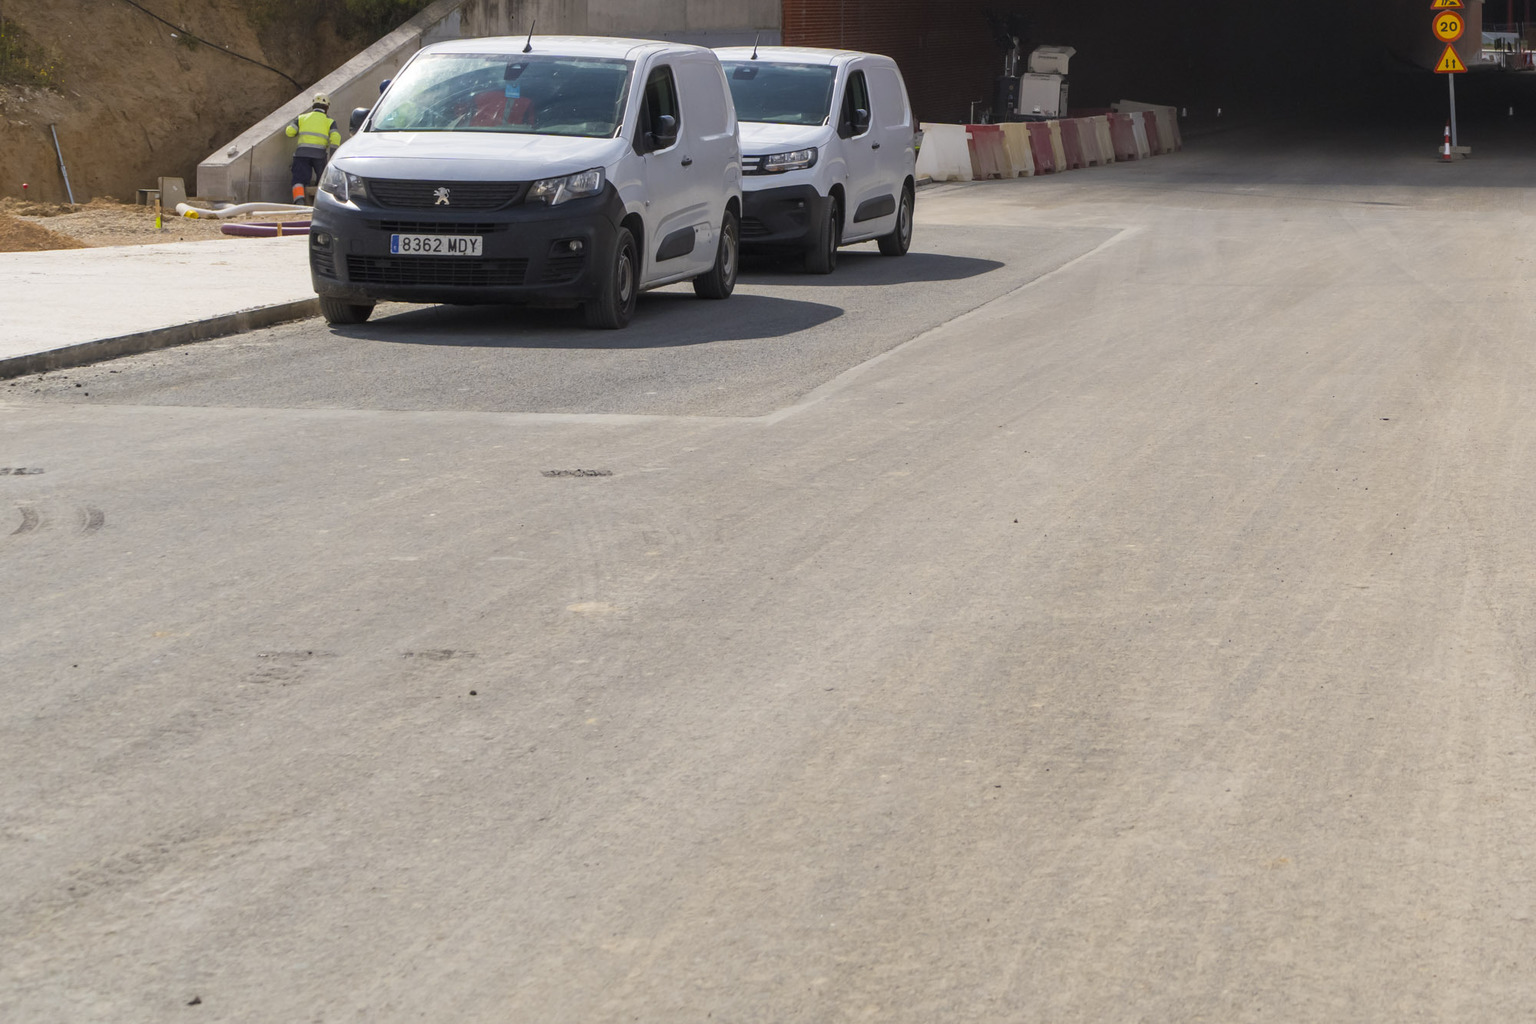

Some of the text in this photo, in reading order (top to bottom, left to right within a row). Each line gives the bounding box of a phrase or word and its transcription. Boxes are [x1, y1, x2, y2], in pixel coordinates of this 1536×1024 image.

[1440, 21, 1458, 32] 20
[402, 237, 442, 253] 8362
[447, 238, 478, 253] MDY
